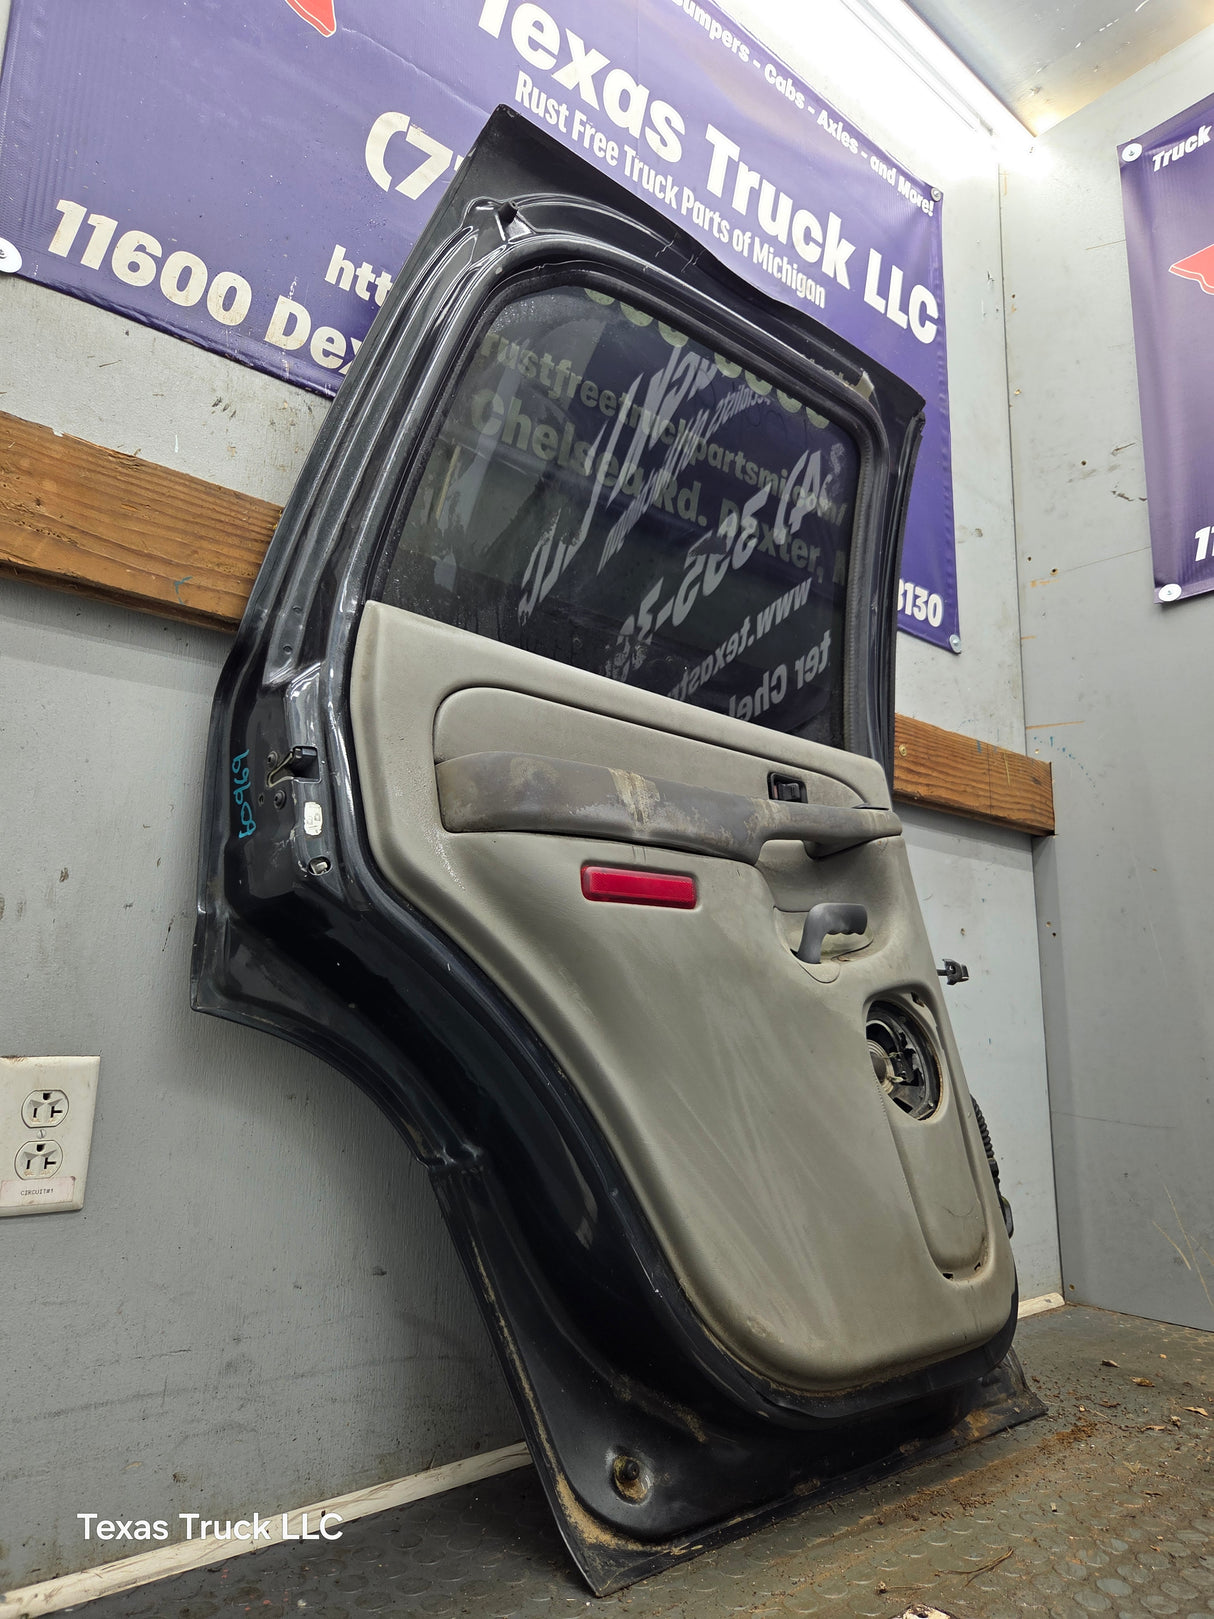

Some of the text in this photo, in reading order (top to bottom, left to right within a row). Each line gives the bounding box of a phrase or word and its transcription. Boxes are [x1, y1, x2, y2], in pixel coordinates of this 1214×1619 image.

[365, 111, 464, 200] (7
[514, 71, 826, 310] Rust Free Truck Parts of Michigan
[764, 63, 805, 109] Cabs
[817, 109, 858, 154] Axles
[870, 155, 897, 186] and
[897, 175, 934, 217] More!
[1152, 125, 1212, 172] Truck
[47, 199, 253, 326] 11600
[704, 124, 857, 290] Truck
[863, 248, 939, 344] LLC
[1194, 525, 1214, 562] 1
